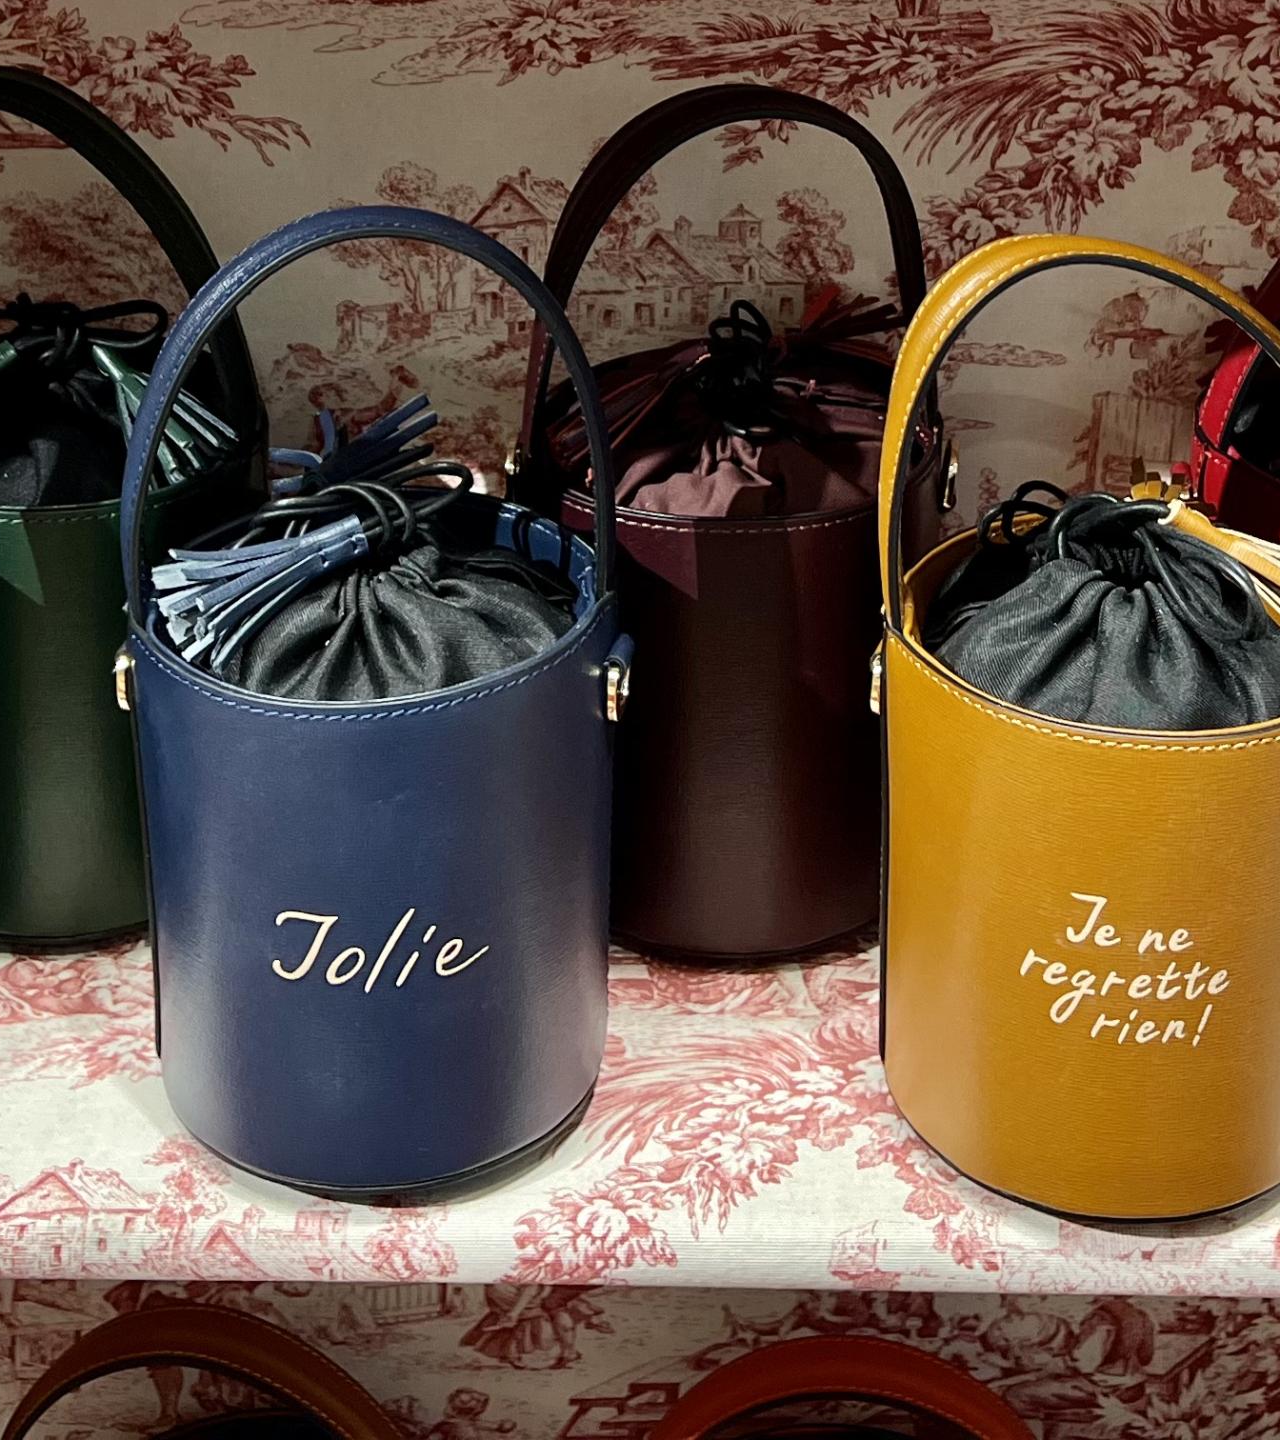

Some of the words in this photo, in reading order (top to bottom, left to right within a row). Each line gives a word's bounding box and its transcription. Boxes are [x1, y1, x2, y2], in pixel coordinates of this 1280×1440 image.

[271, 907, 490, 994] Jolie
[1066, 891, 1121, 947] Je
[1137, 928, 1194, 954] ne
[1019, 948, 1230, 1024] regrette
[1090, 1003, 1213, 1047] rien!
